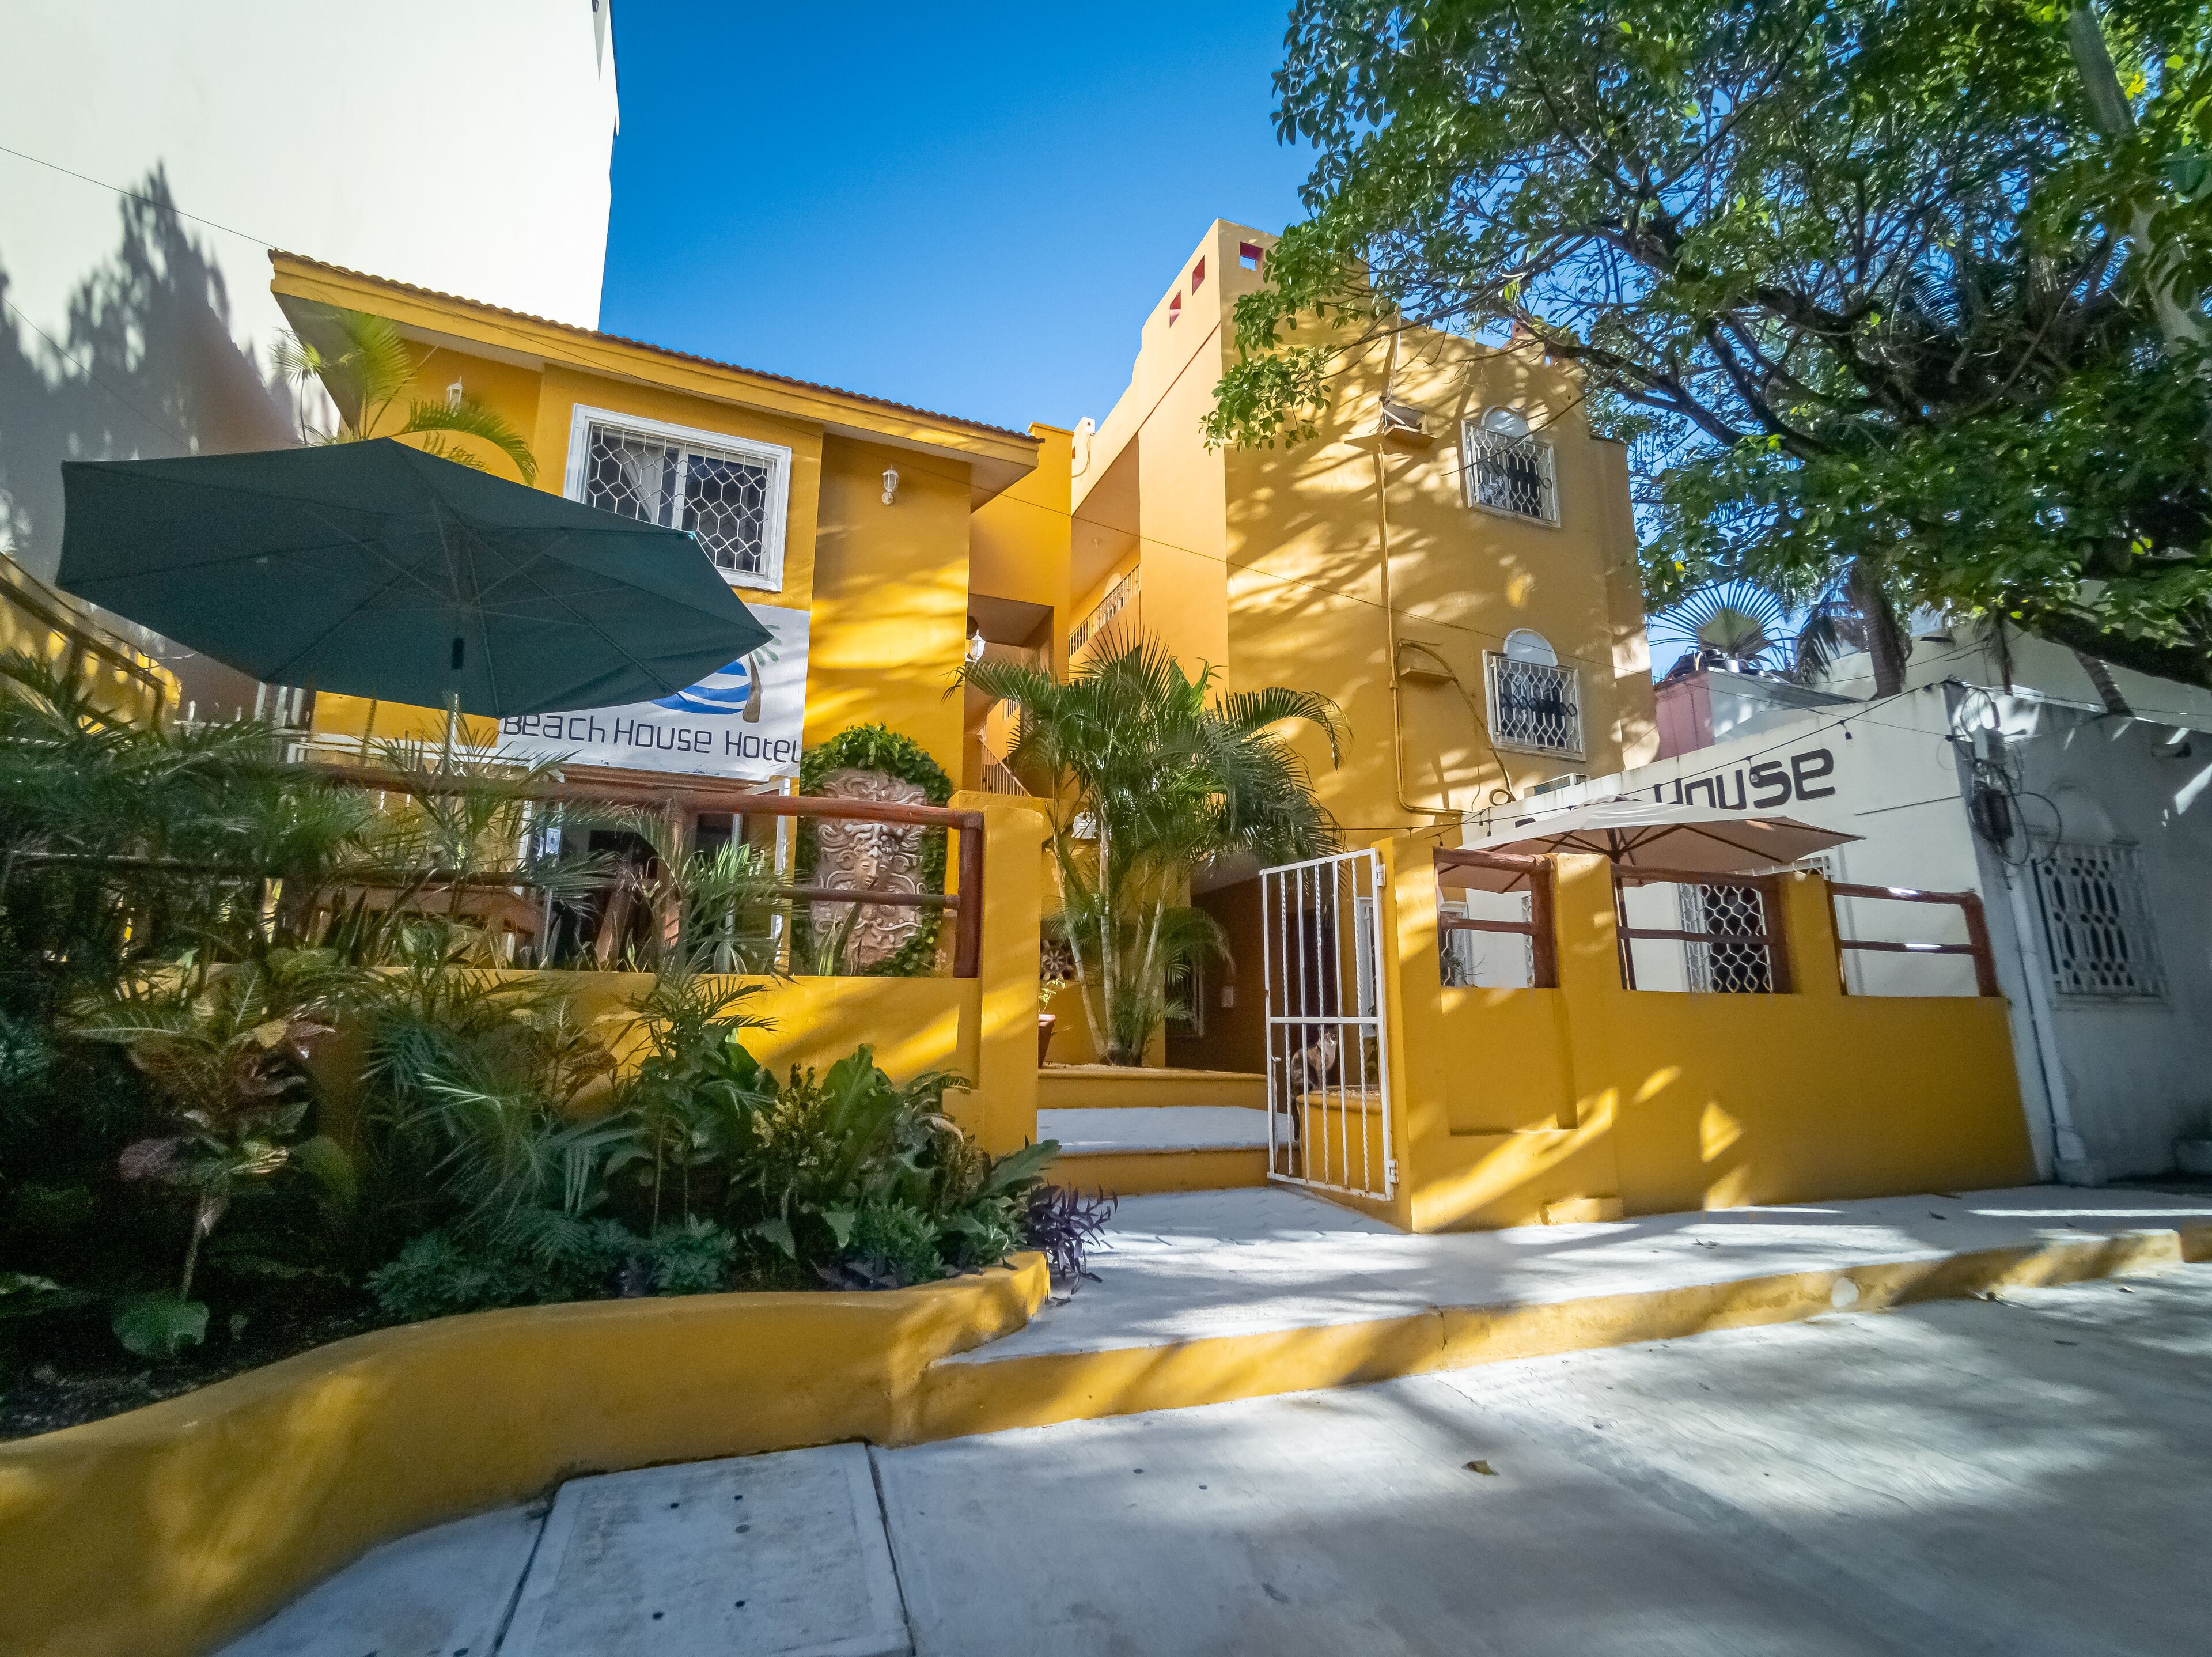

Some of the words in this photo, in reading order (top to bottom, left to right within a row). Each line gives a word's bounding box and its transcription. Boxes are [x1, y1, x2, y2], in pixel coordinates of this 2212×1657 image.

[503, 714, 605, 743] Beach
[613, 717, 713, 754] House
[725, 730, 800, 763] Hotel
